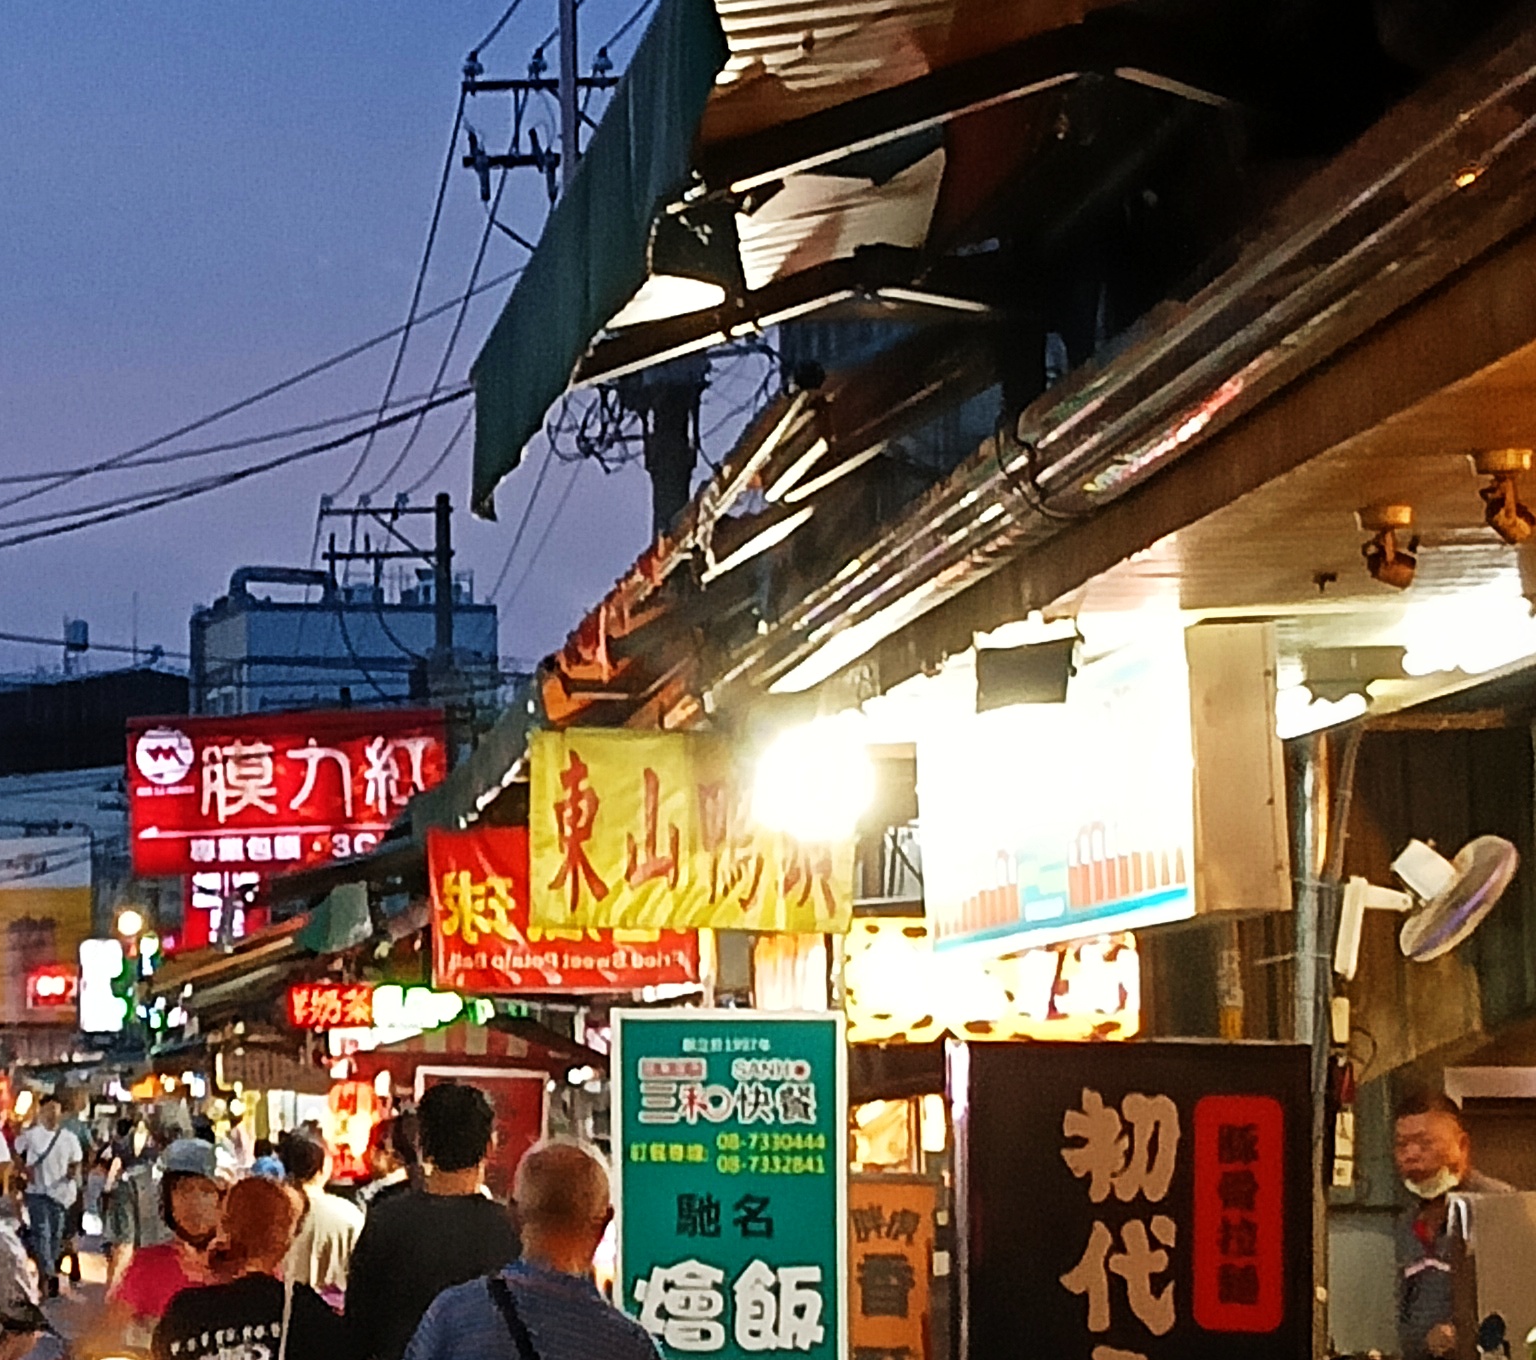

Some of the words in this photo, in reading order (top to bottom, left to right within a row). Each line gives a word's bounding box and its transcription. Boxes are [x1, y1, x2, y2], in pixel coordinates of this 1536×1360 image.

[638, 1081, 817, 1126] 三和快餐
[676, 1192, 774, 1238] 馳名
